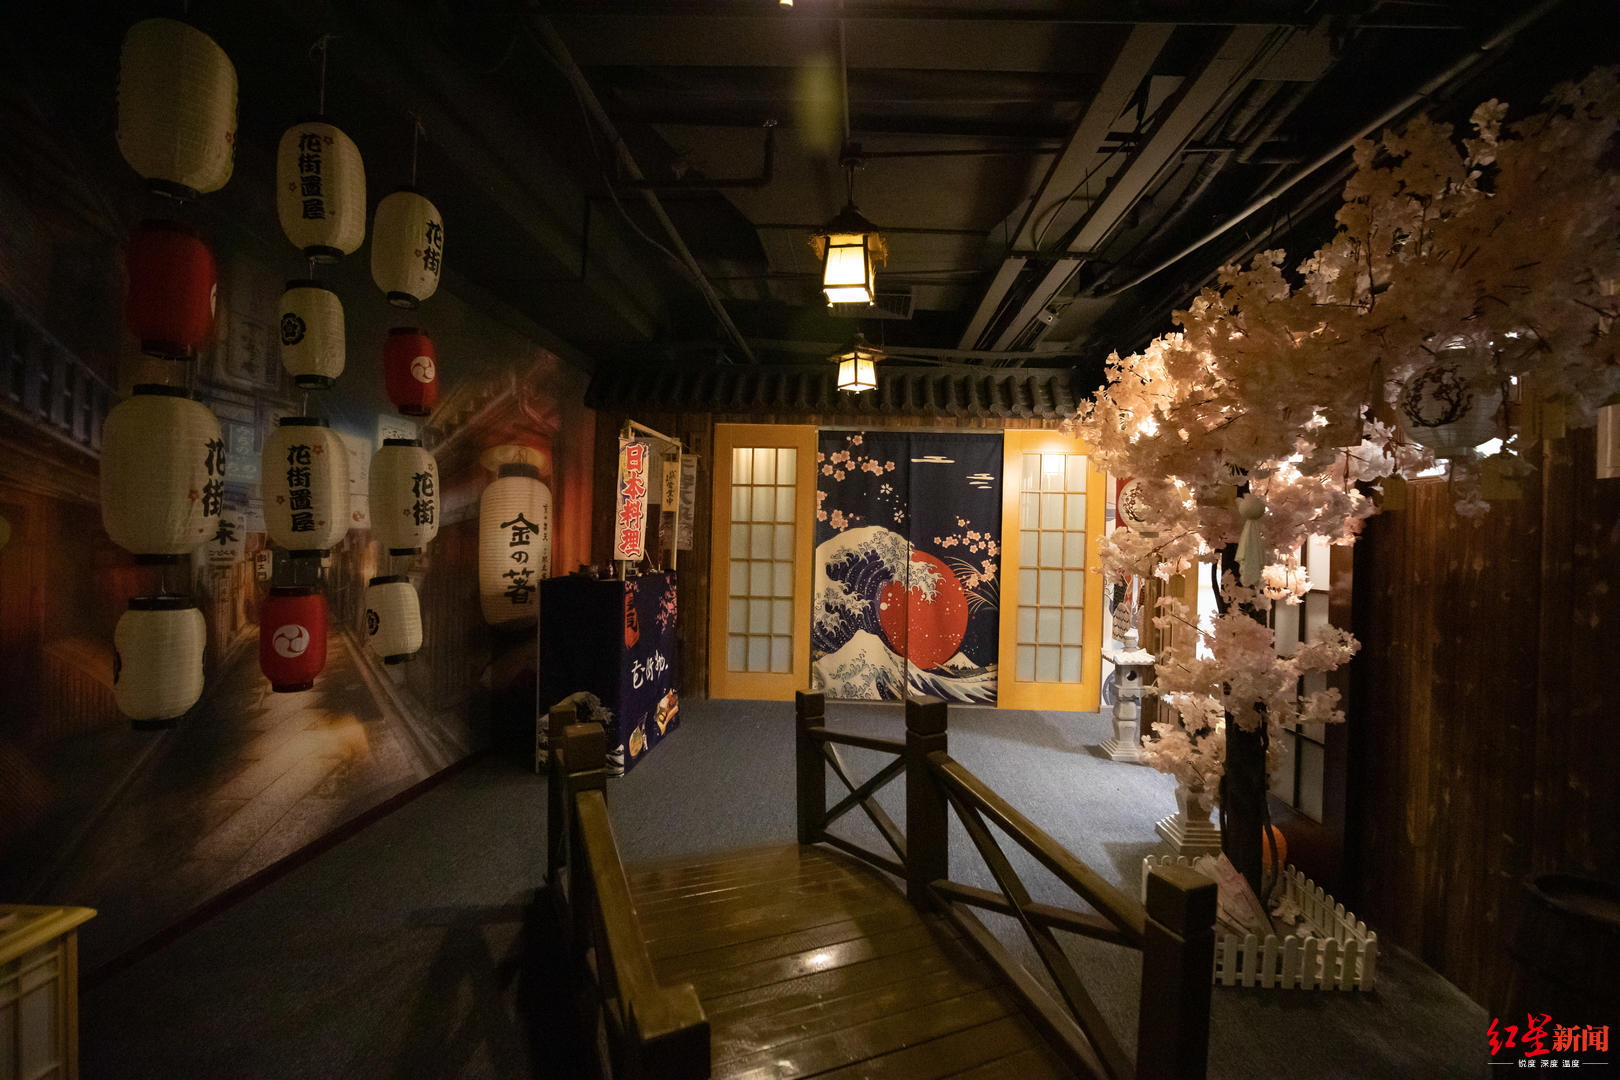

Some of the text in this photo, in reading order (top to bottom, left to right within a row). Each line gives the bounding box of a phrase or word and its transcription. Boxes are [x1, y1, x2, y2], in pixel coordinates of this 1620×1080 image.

[423, 219, 444, 277] 花街
[412, 472, 435, 526] 花街
[617, 443, 646, 557] 日本料理
